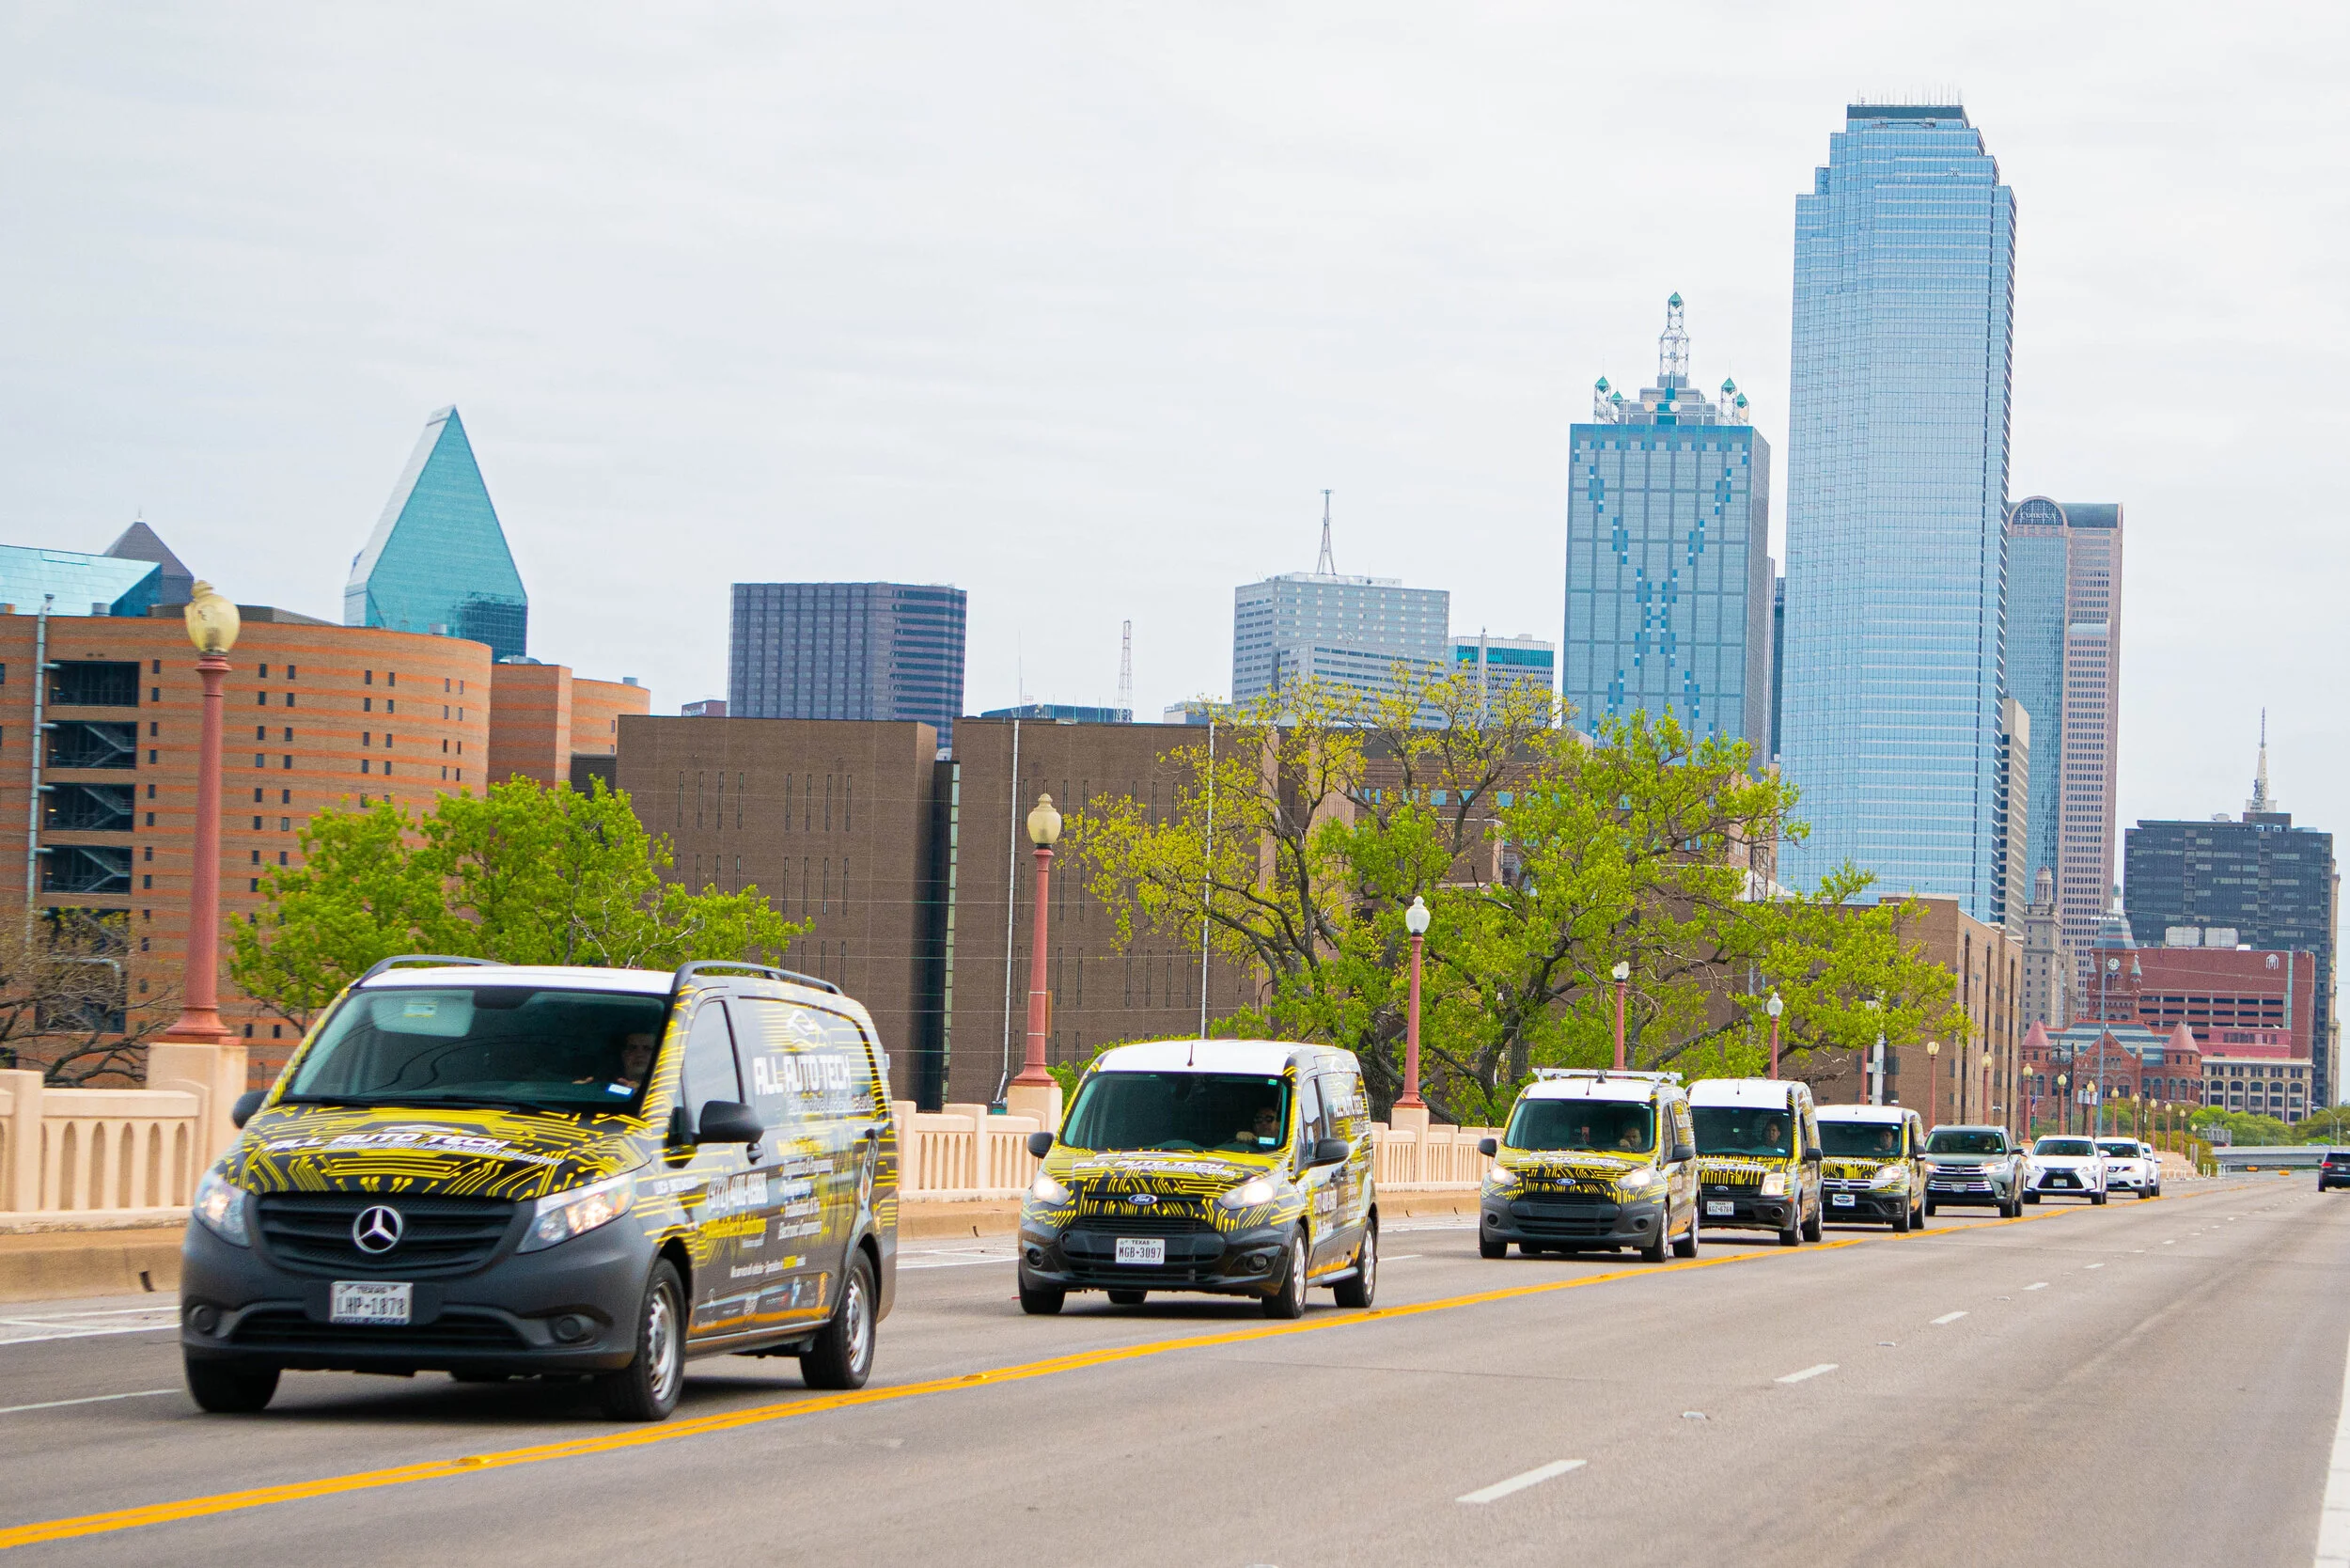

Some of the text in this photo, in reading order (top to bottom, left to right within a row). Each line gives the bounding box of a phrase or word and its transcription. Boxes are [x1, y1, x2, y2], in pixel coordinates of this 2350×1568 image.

[754, 1055, 851, 1095] ALL AUTO TECH
[262, 1133, 511, 1151] ALL AUTO TECH
